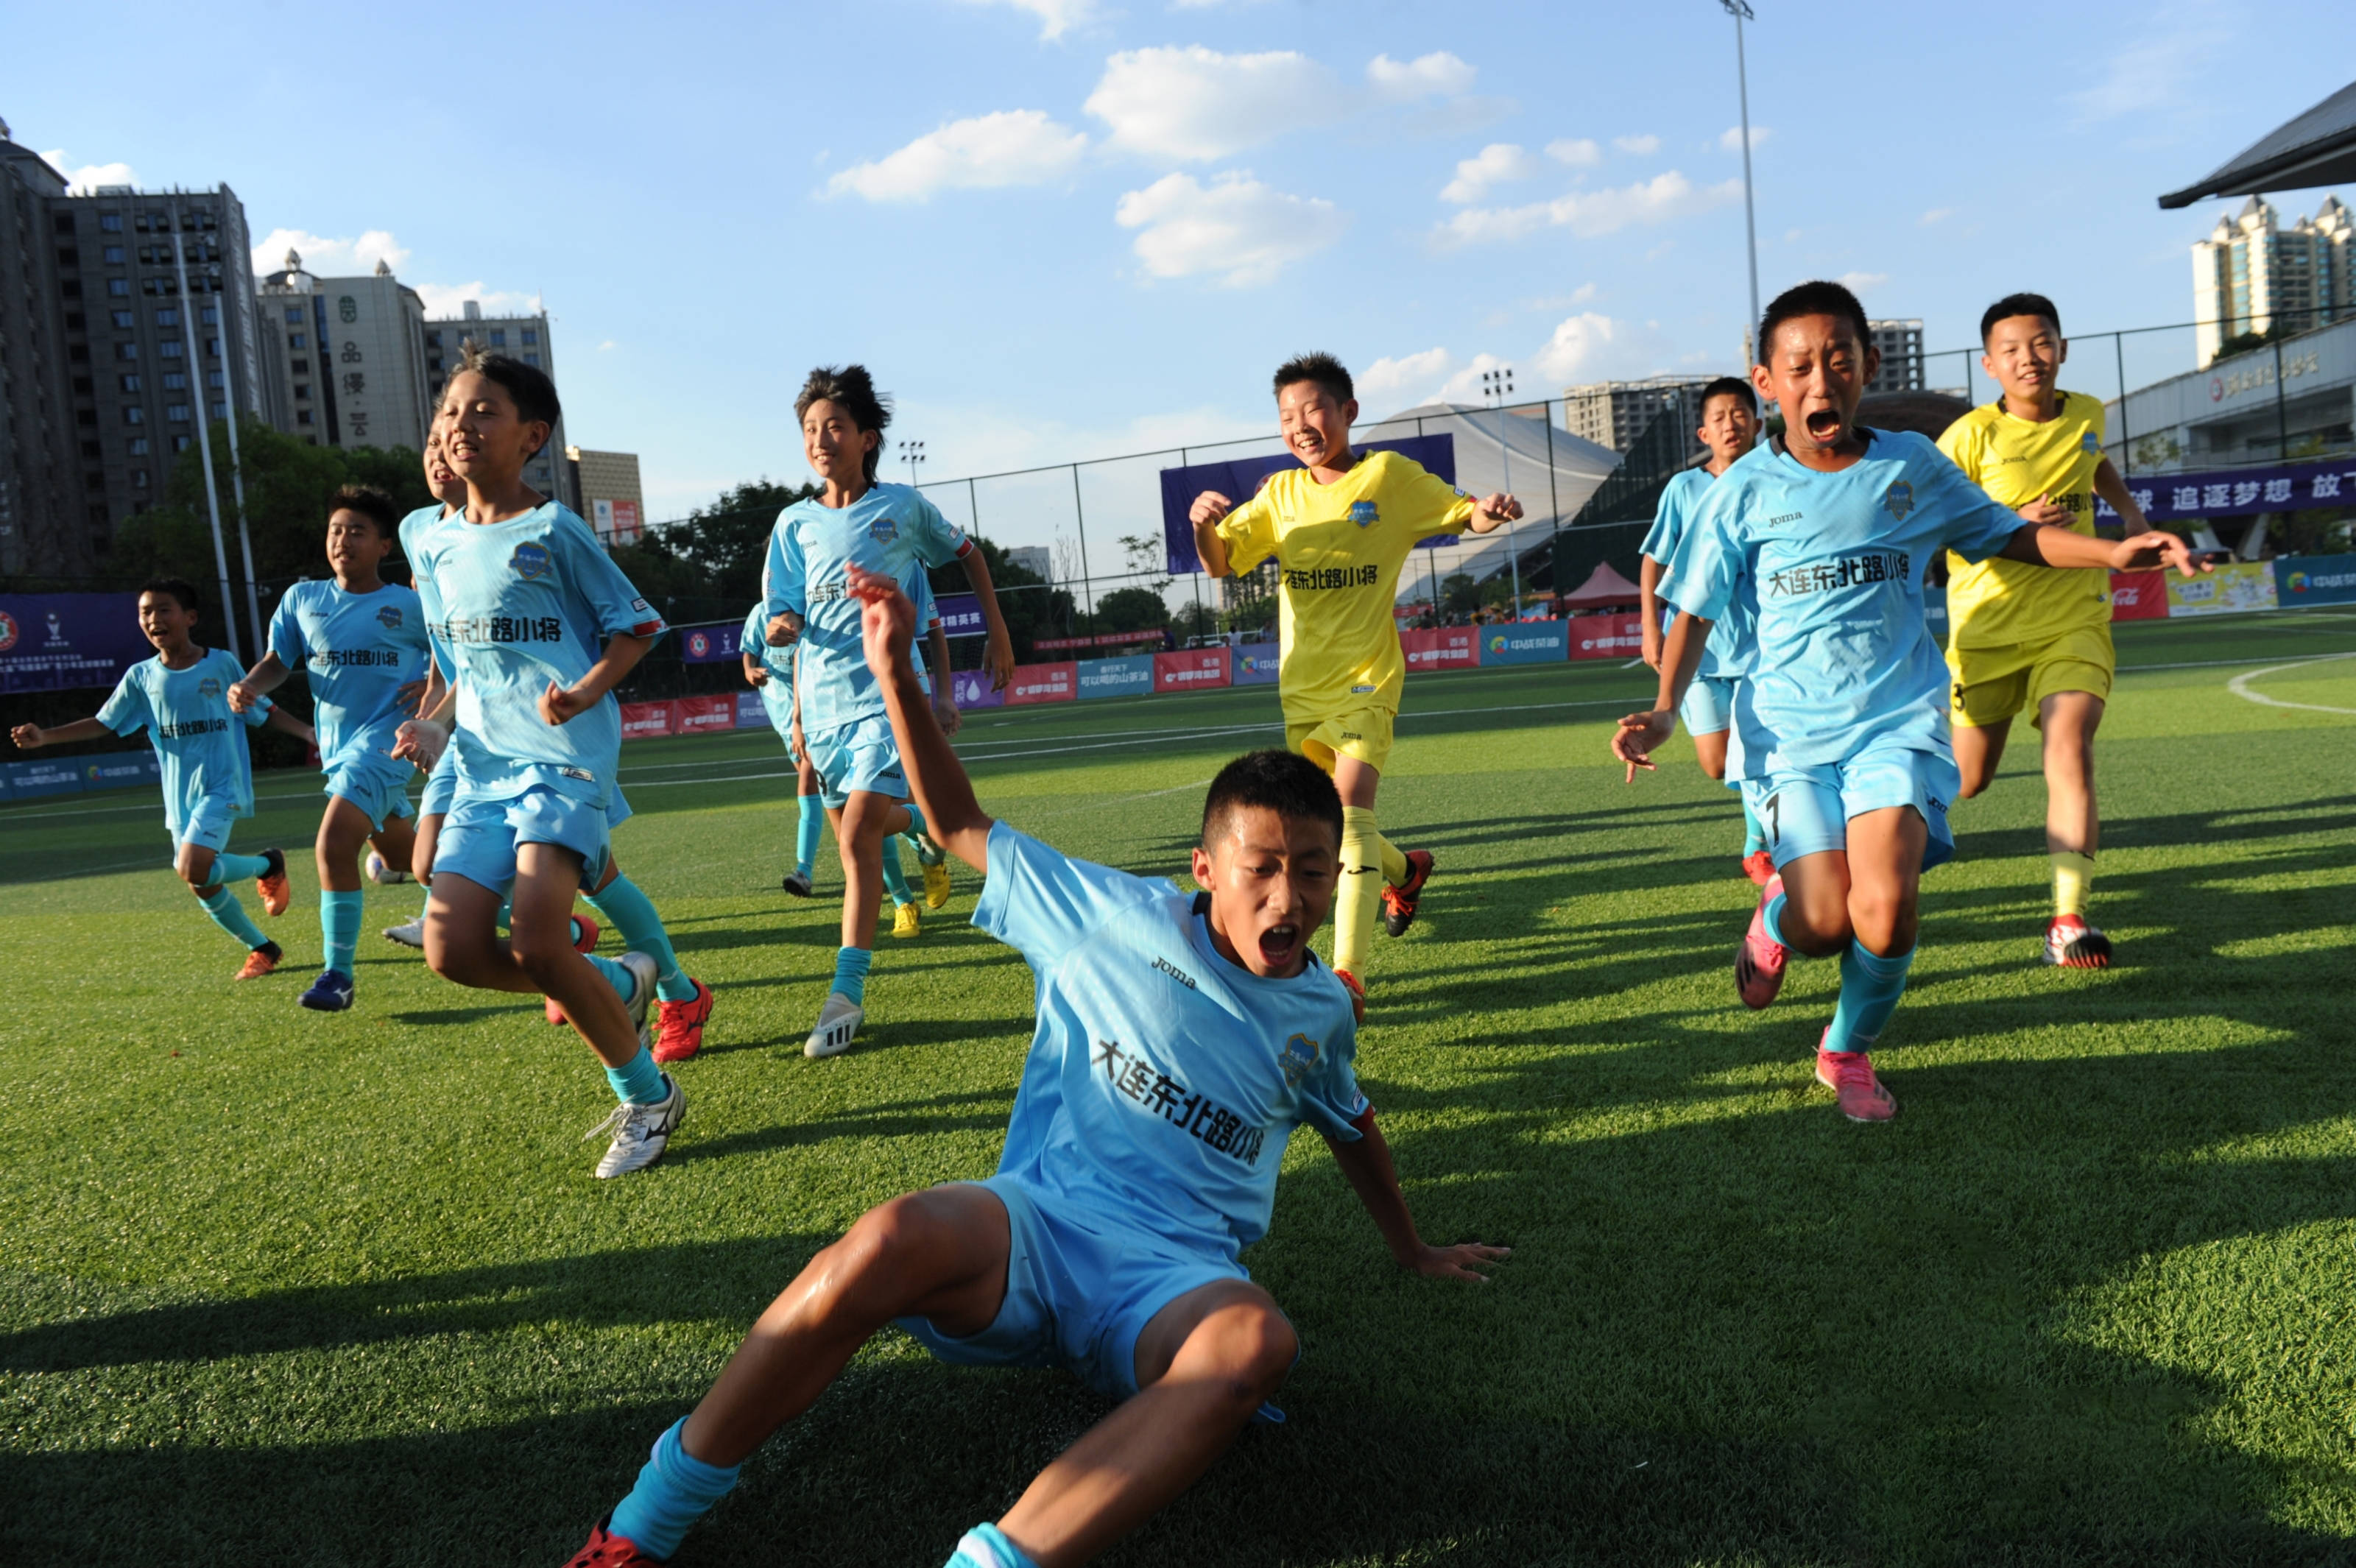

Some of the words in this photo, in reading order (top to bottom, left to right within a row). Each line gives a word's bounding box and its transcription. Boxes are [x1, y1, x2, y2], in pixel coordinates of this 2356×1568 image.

[2173, 478, 2292, 511] 追逐梦想
[1768, 553, 1909, 598] 大连东北路小将
[1151, 955, 1196, 990] Joma
[1091, 1039, 1265, 1167] 大连东北路小将
